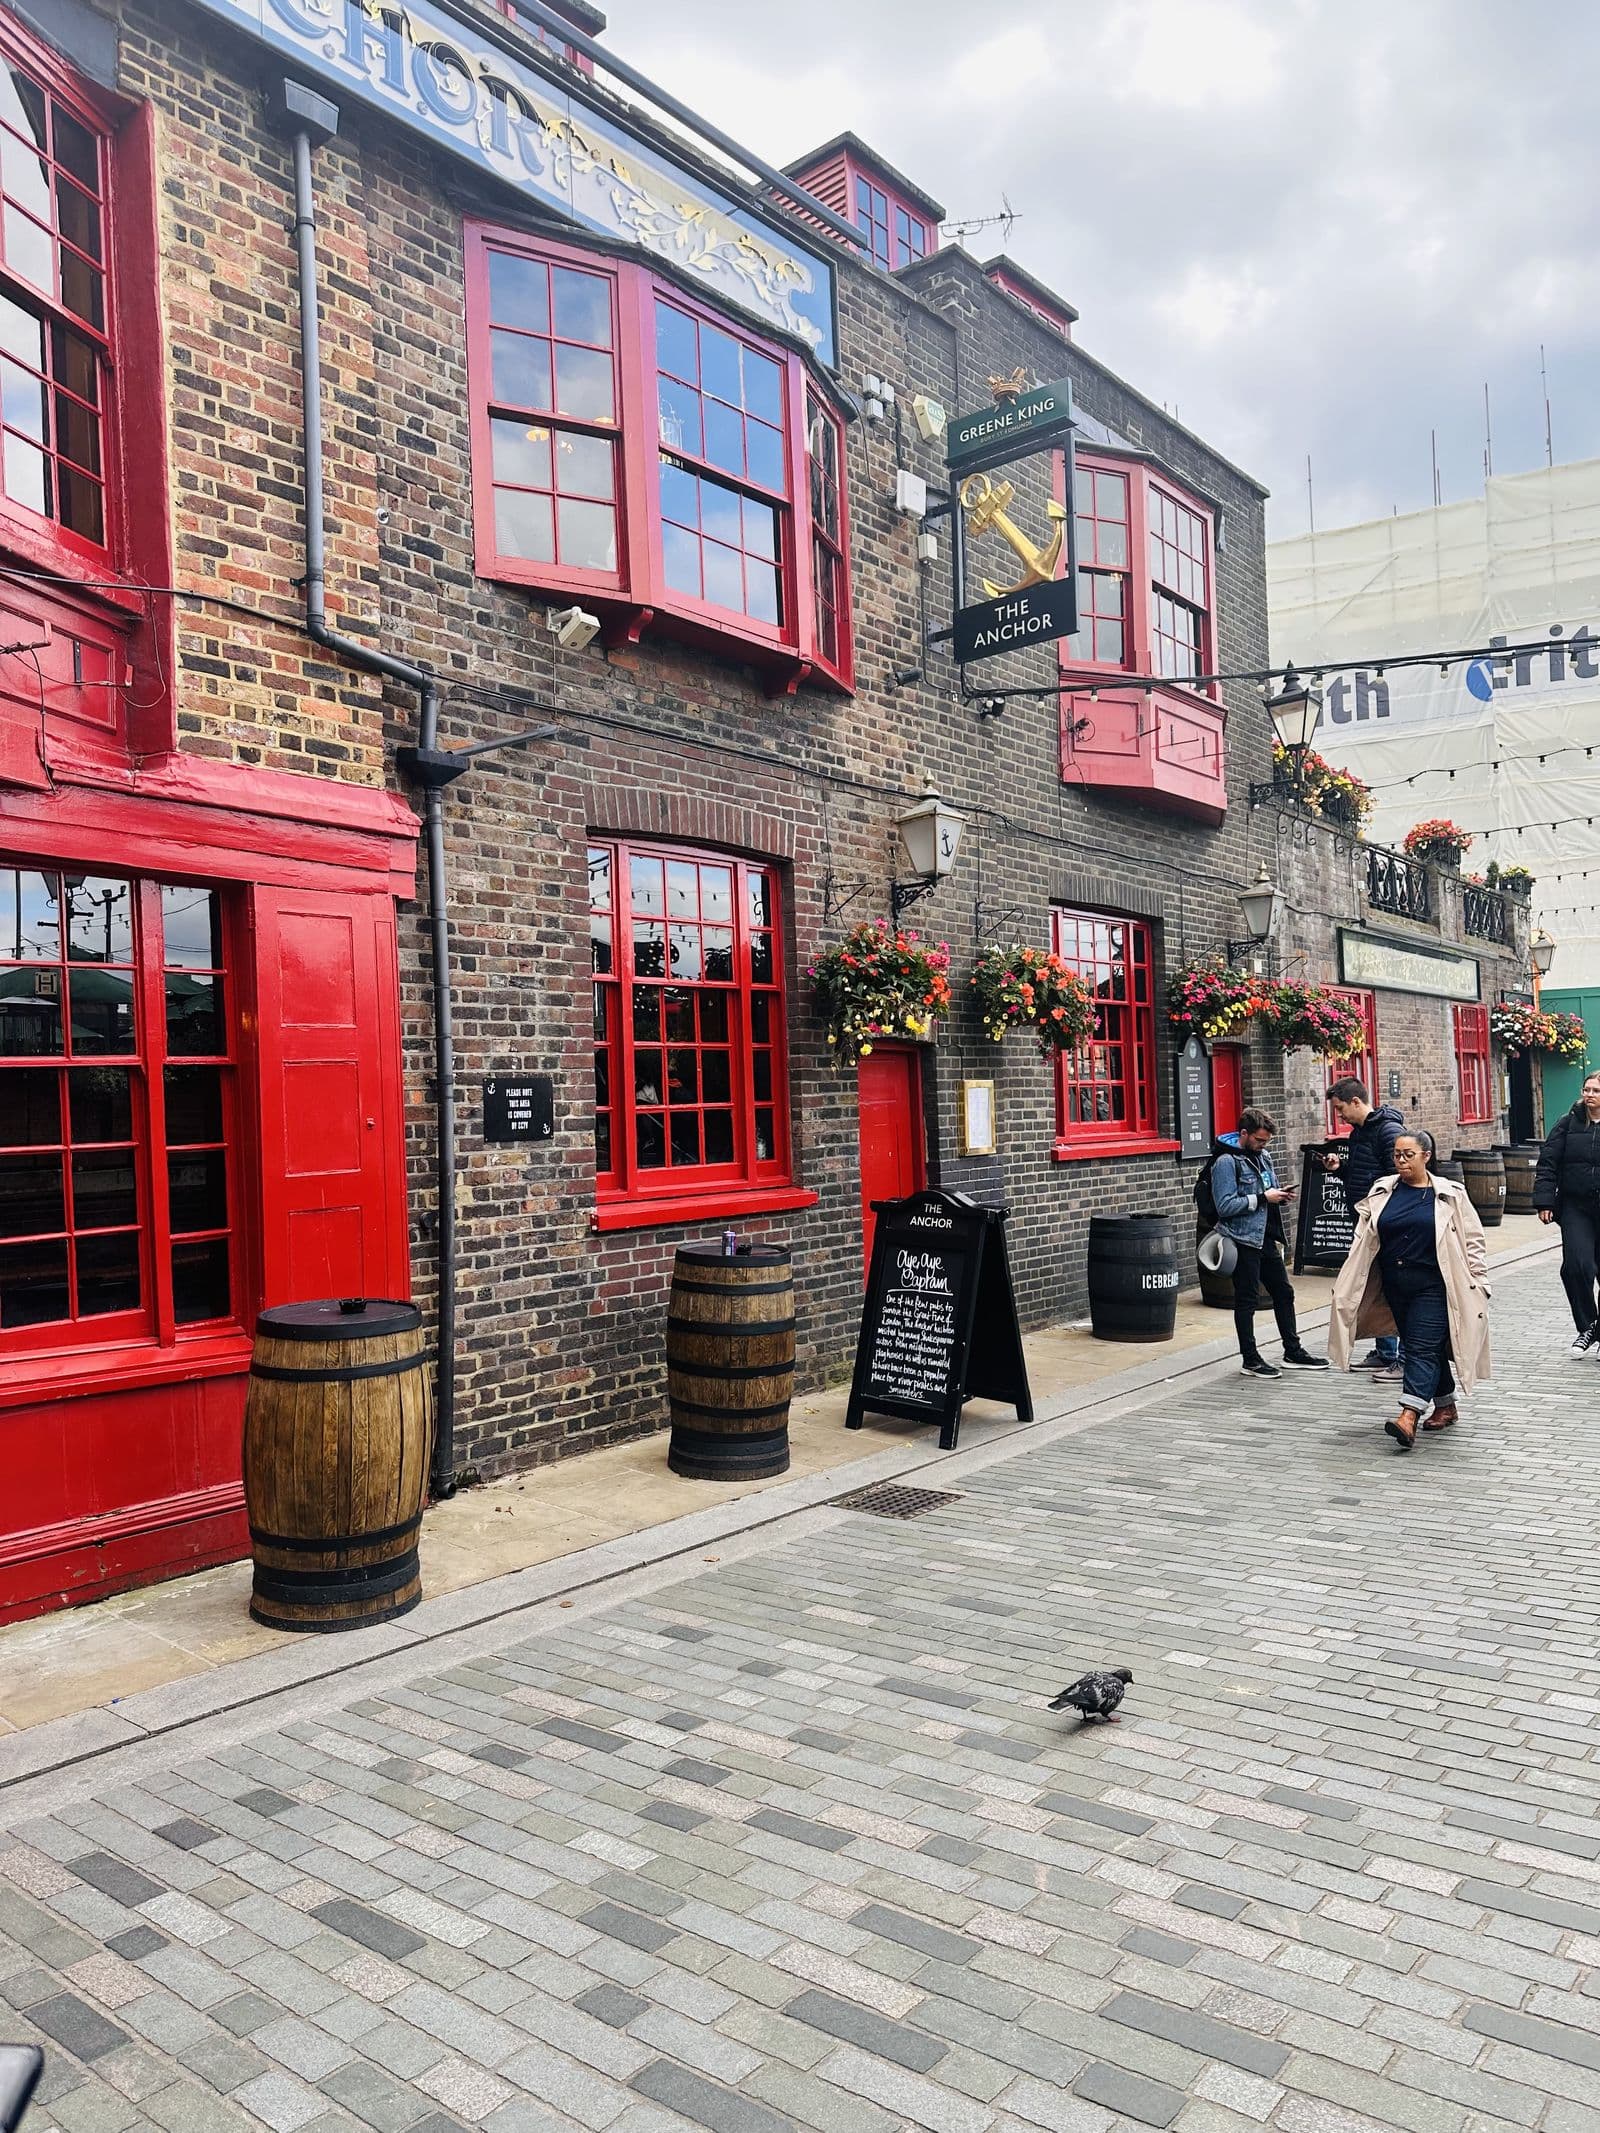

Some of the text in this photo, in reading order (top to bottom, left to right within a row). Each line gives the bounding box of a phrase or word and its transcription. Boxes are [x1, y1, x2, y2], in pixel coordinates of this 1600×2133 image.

[959, 398, 1055, 442] GREENE KING
[994, 598, 1029, 622] THE
[973, 613, 1053, 648] ANCHOR
[506, 1088, 533, 1096] PLEASE NOTE
[508, 1110, 532, 1119] IS COVERED
[511, 1121, 528, 1130] BY CCTV
[1321, 1185, 1341, 1200] Fish
[924, 1203, 943, 1213] THE
[910, 1216, 953, 1229] ANCHOR
[901, 1268, 951, 1292] Captain
[886, 1294, 954, 1312] One of the few pubs to
[881, 1314, 954, 1334] London, The Anchor has been
[902, 1307, 913, 1317] the
[914, 1308, 931, 1320] Great
[931, 1311, 945, 1323] Fire
[945, 1313, 954, 1328] of
[897, 1328, 905, 1342] by
[905, 1331, 920, 1344] many
[875, 1337, 947, 1360] actors from neighbouring
[905, 1354, 912, 1362] as
[872, 1359, 878, 1369] to
[878, 1361, 890, 1370] have
[903, 1364, 917, 1375] been
[923, 1368, 947, 1382] popular
[871, 1371, 947, 1394] place for river pirates and
